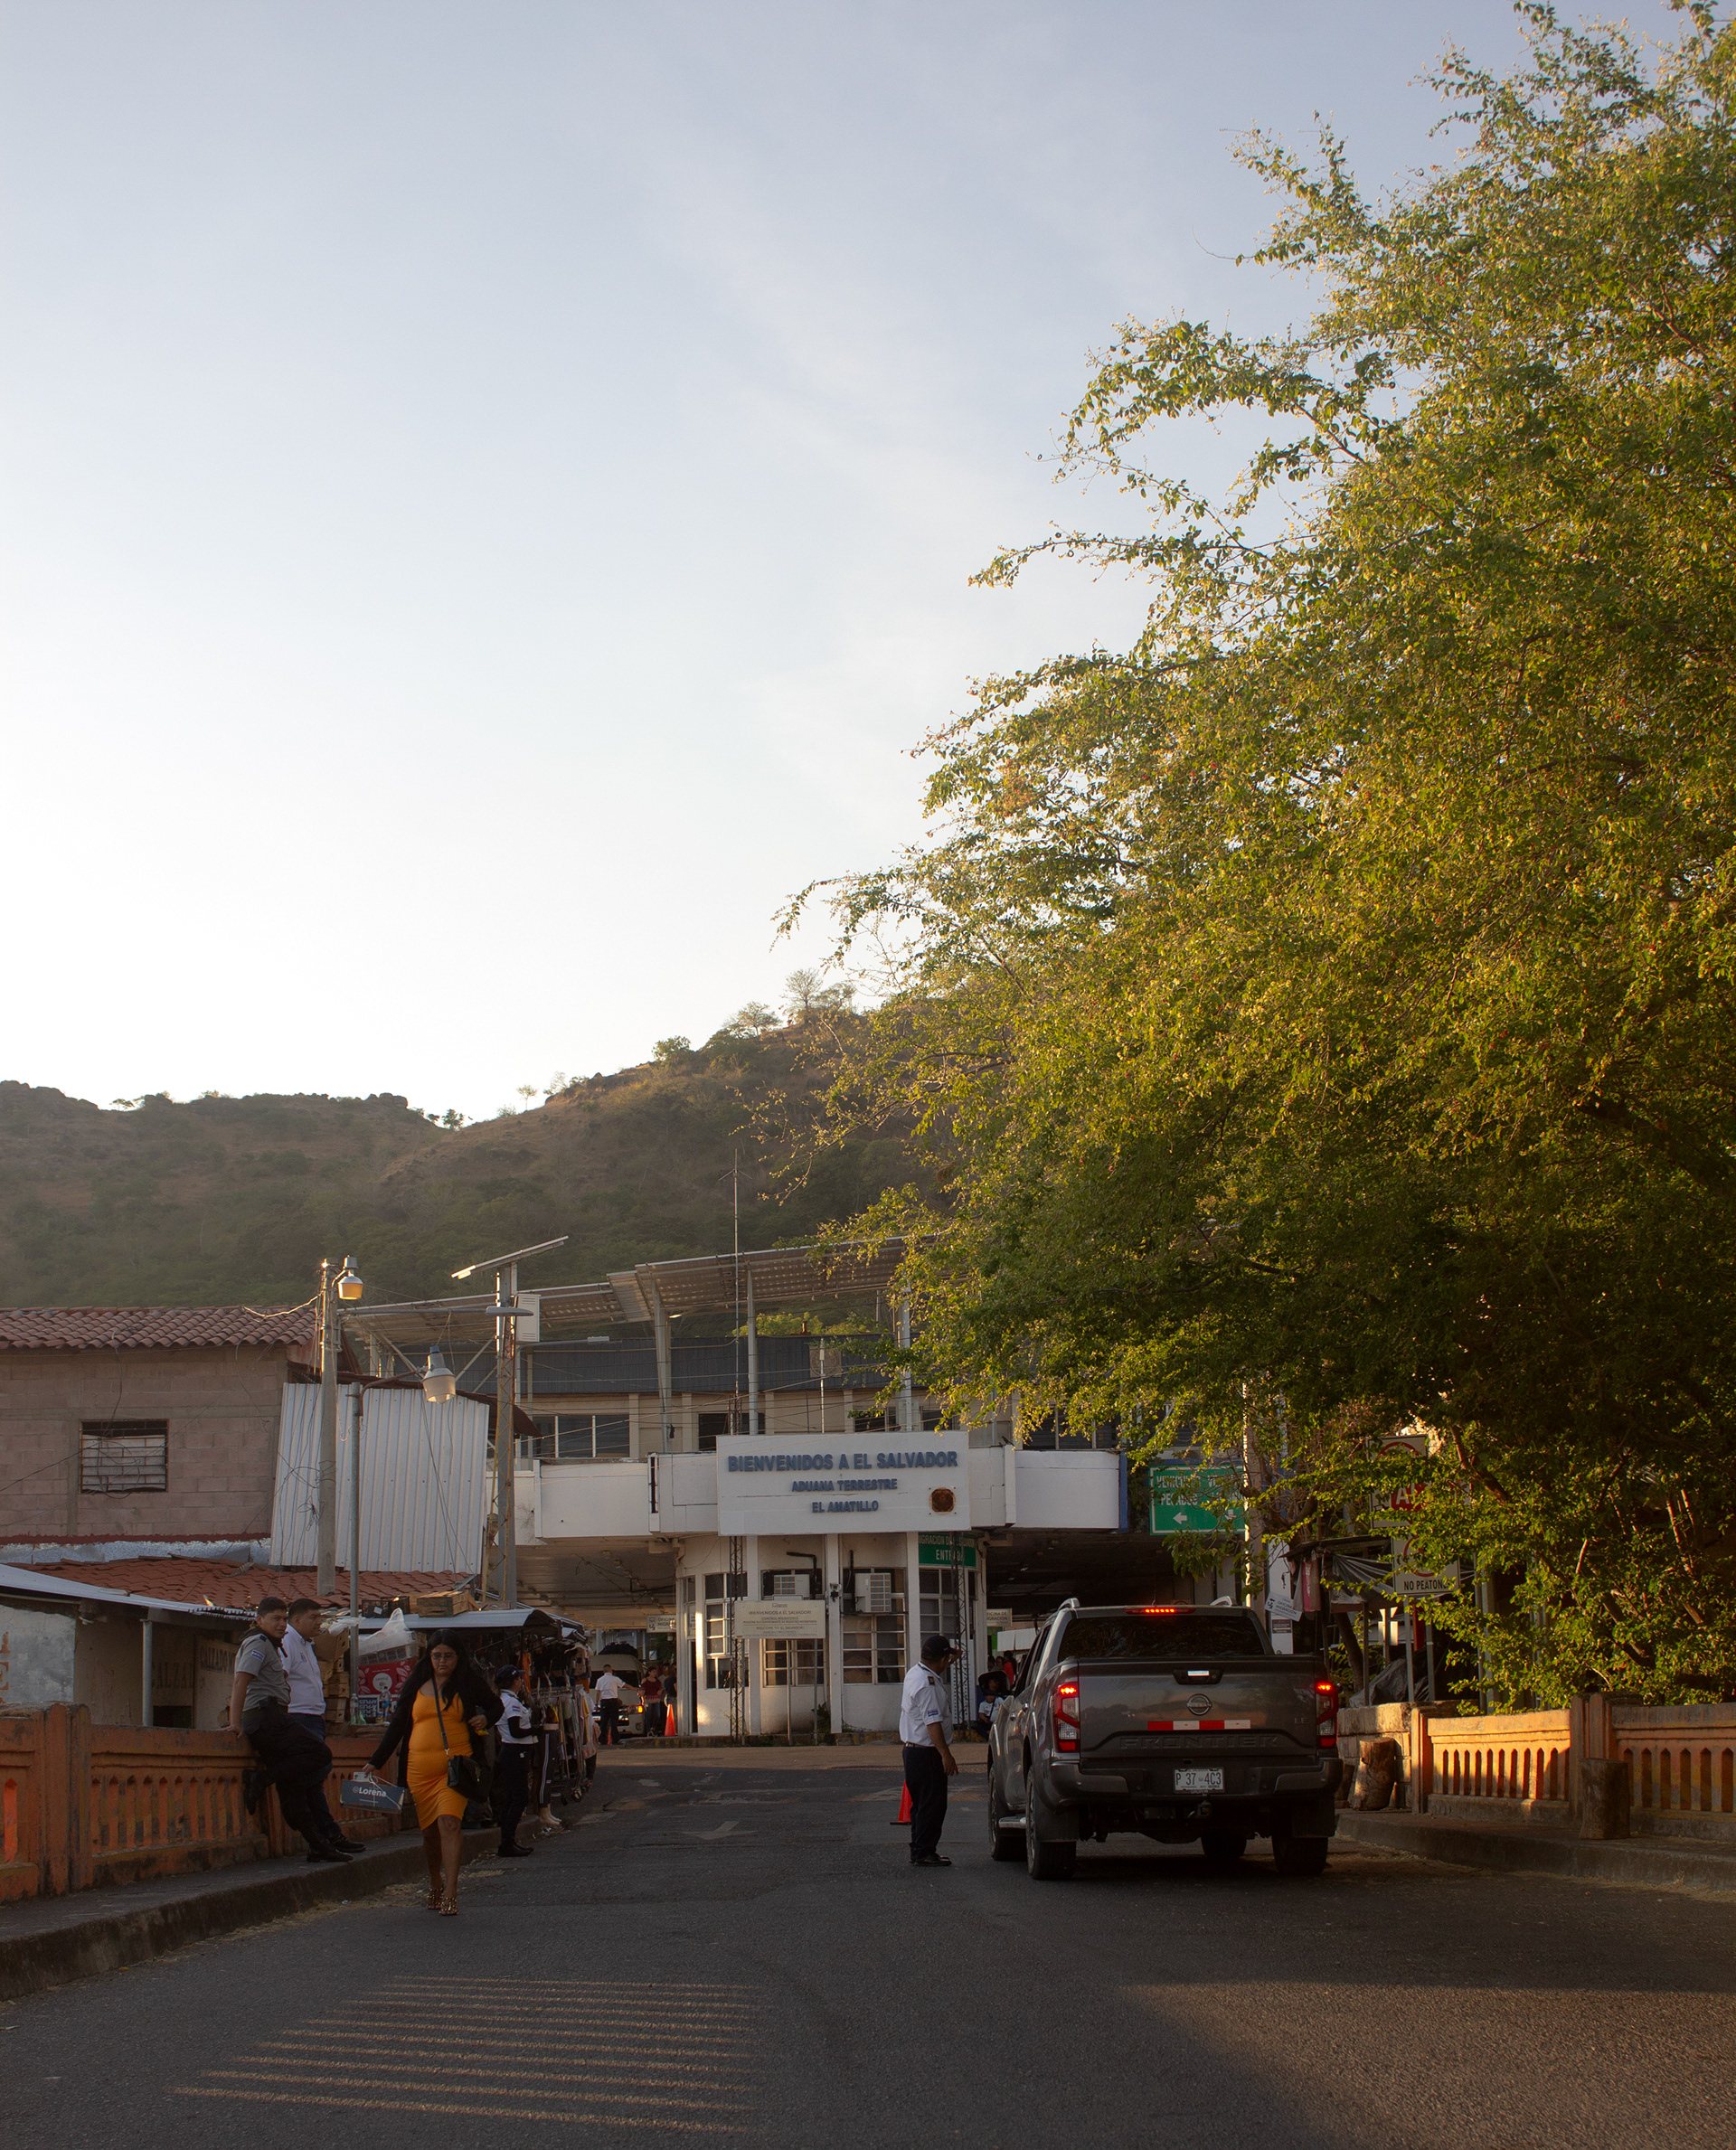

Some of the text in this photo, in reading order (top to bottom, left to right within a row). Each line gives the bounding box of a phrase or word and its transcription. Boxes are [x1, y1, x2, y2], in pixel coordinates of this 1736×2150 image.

[728, 1451, 958, 1472] BIENVENIDOS A EL SALVADOR
[791, 1478, 898, 1492] ADUANA TERRESTRE
[1156, 1475, 1202, 1489] VEHICUL
[1160, 1493, 1198, 1506] PEADOS
[812, 1500, 879, 1513] EL AMATILLO
[919, 1534, 945, 1545] IGRACION
[935, 1549, 964, 1561] ENTD
[1403, 1580, 1415, 1591] NO
[152, 1661, 194, 1689] ALZA
[1120, 1734, 1278, 1749] FRONTIER
[1175, 1772, 1222, 1786] P 37 4C3
[359, 1787, 387, 1797] Lorena
